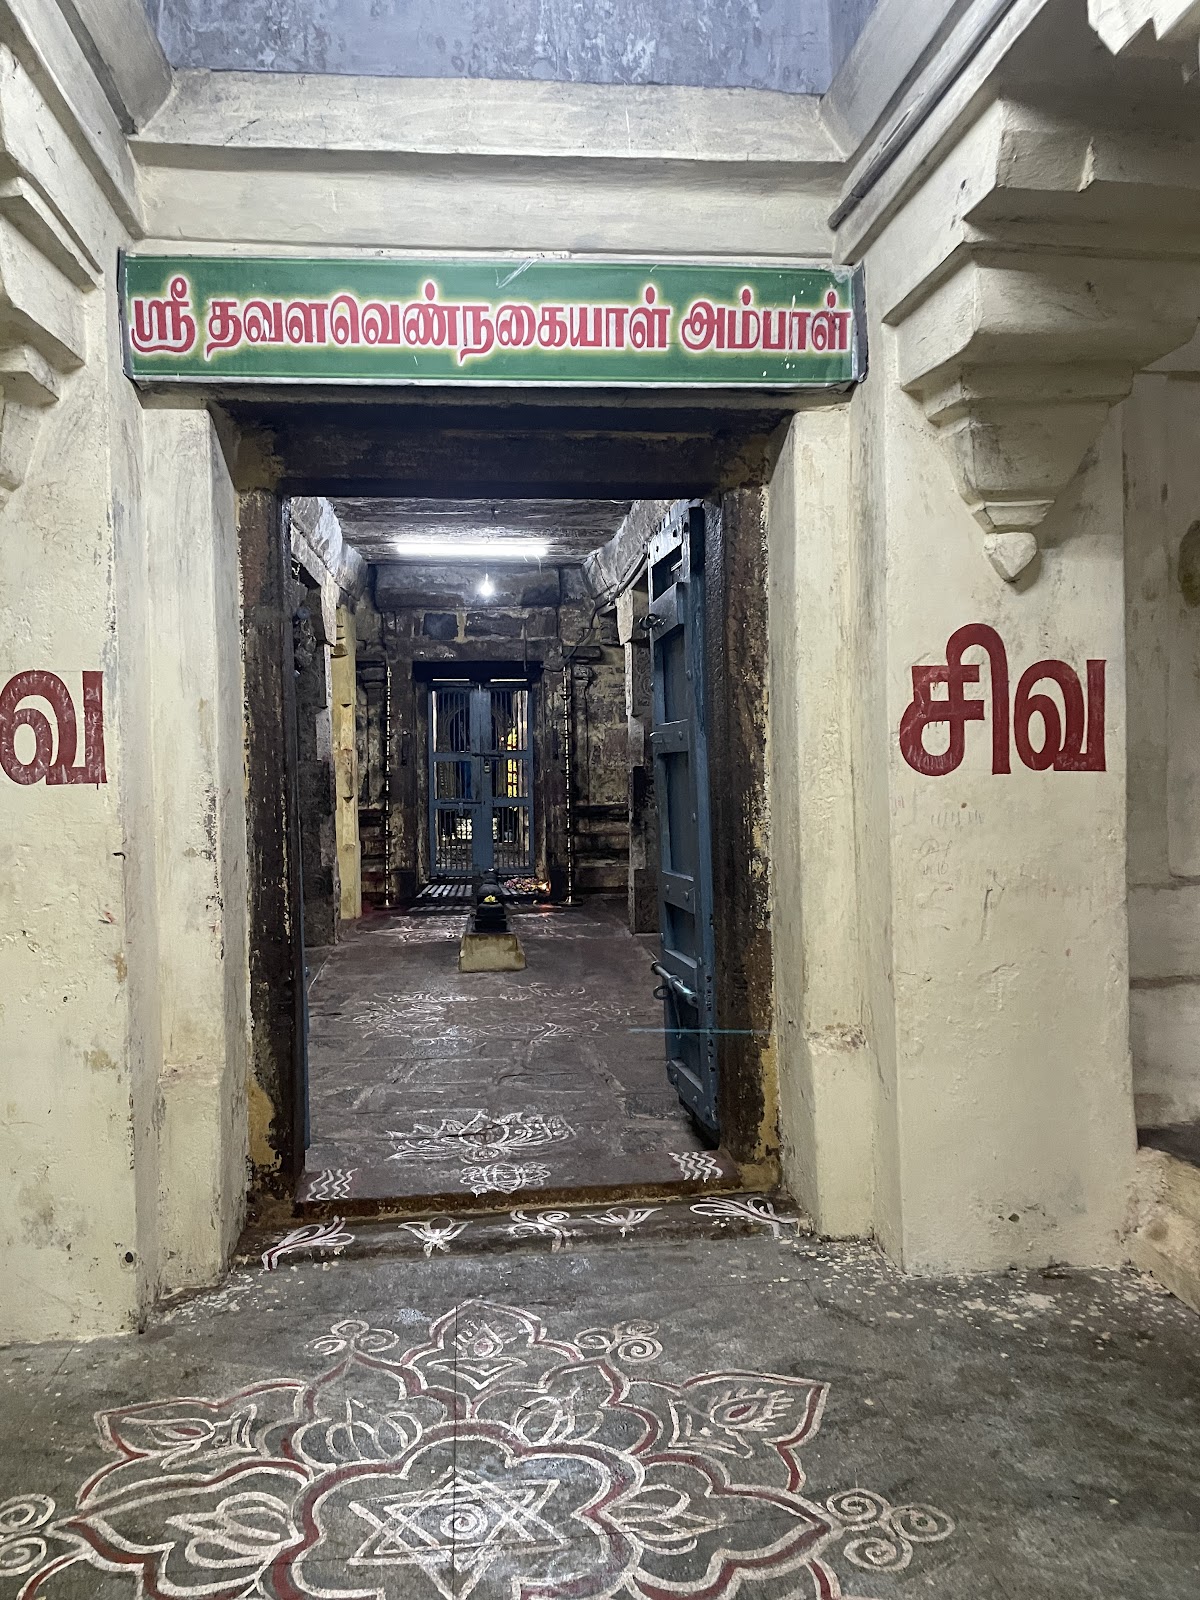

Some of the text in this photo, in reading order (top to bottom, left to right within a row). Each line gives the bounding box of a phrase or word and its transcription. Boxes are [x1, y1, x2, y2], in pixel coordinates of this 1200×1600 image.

[131, 277, 196, 353] ஸ்ரீ
[681, 287, 851, 351] அம்பாள்
[899, 623, 1107, 777] சிவ
